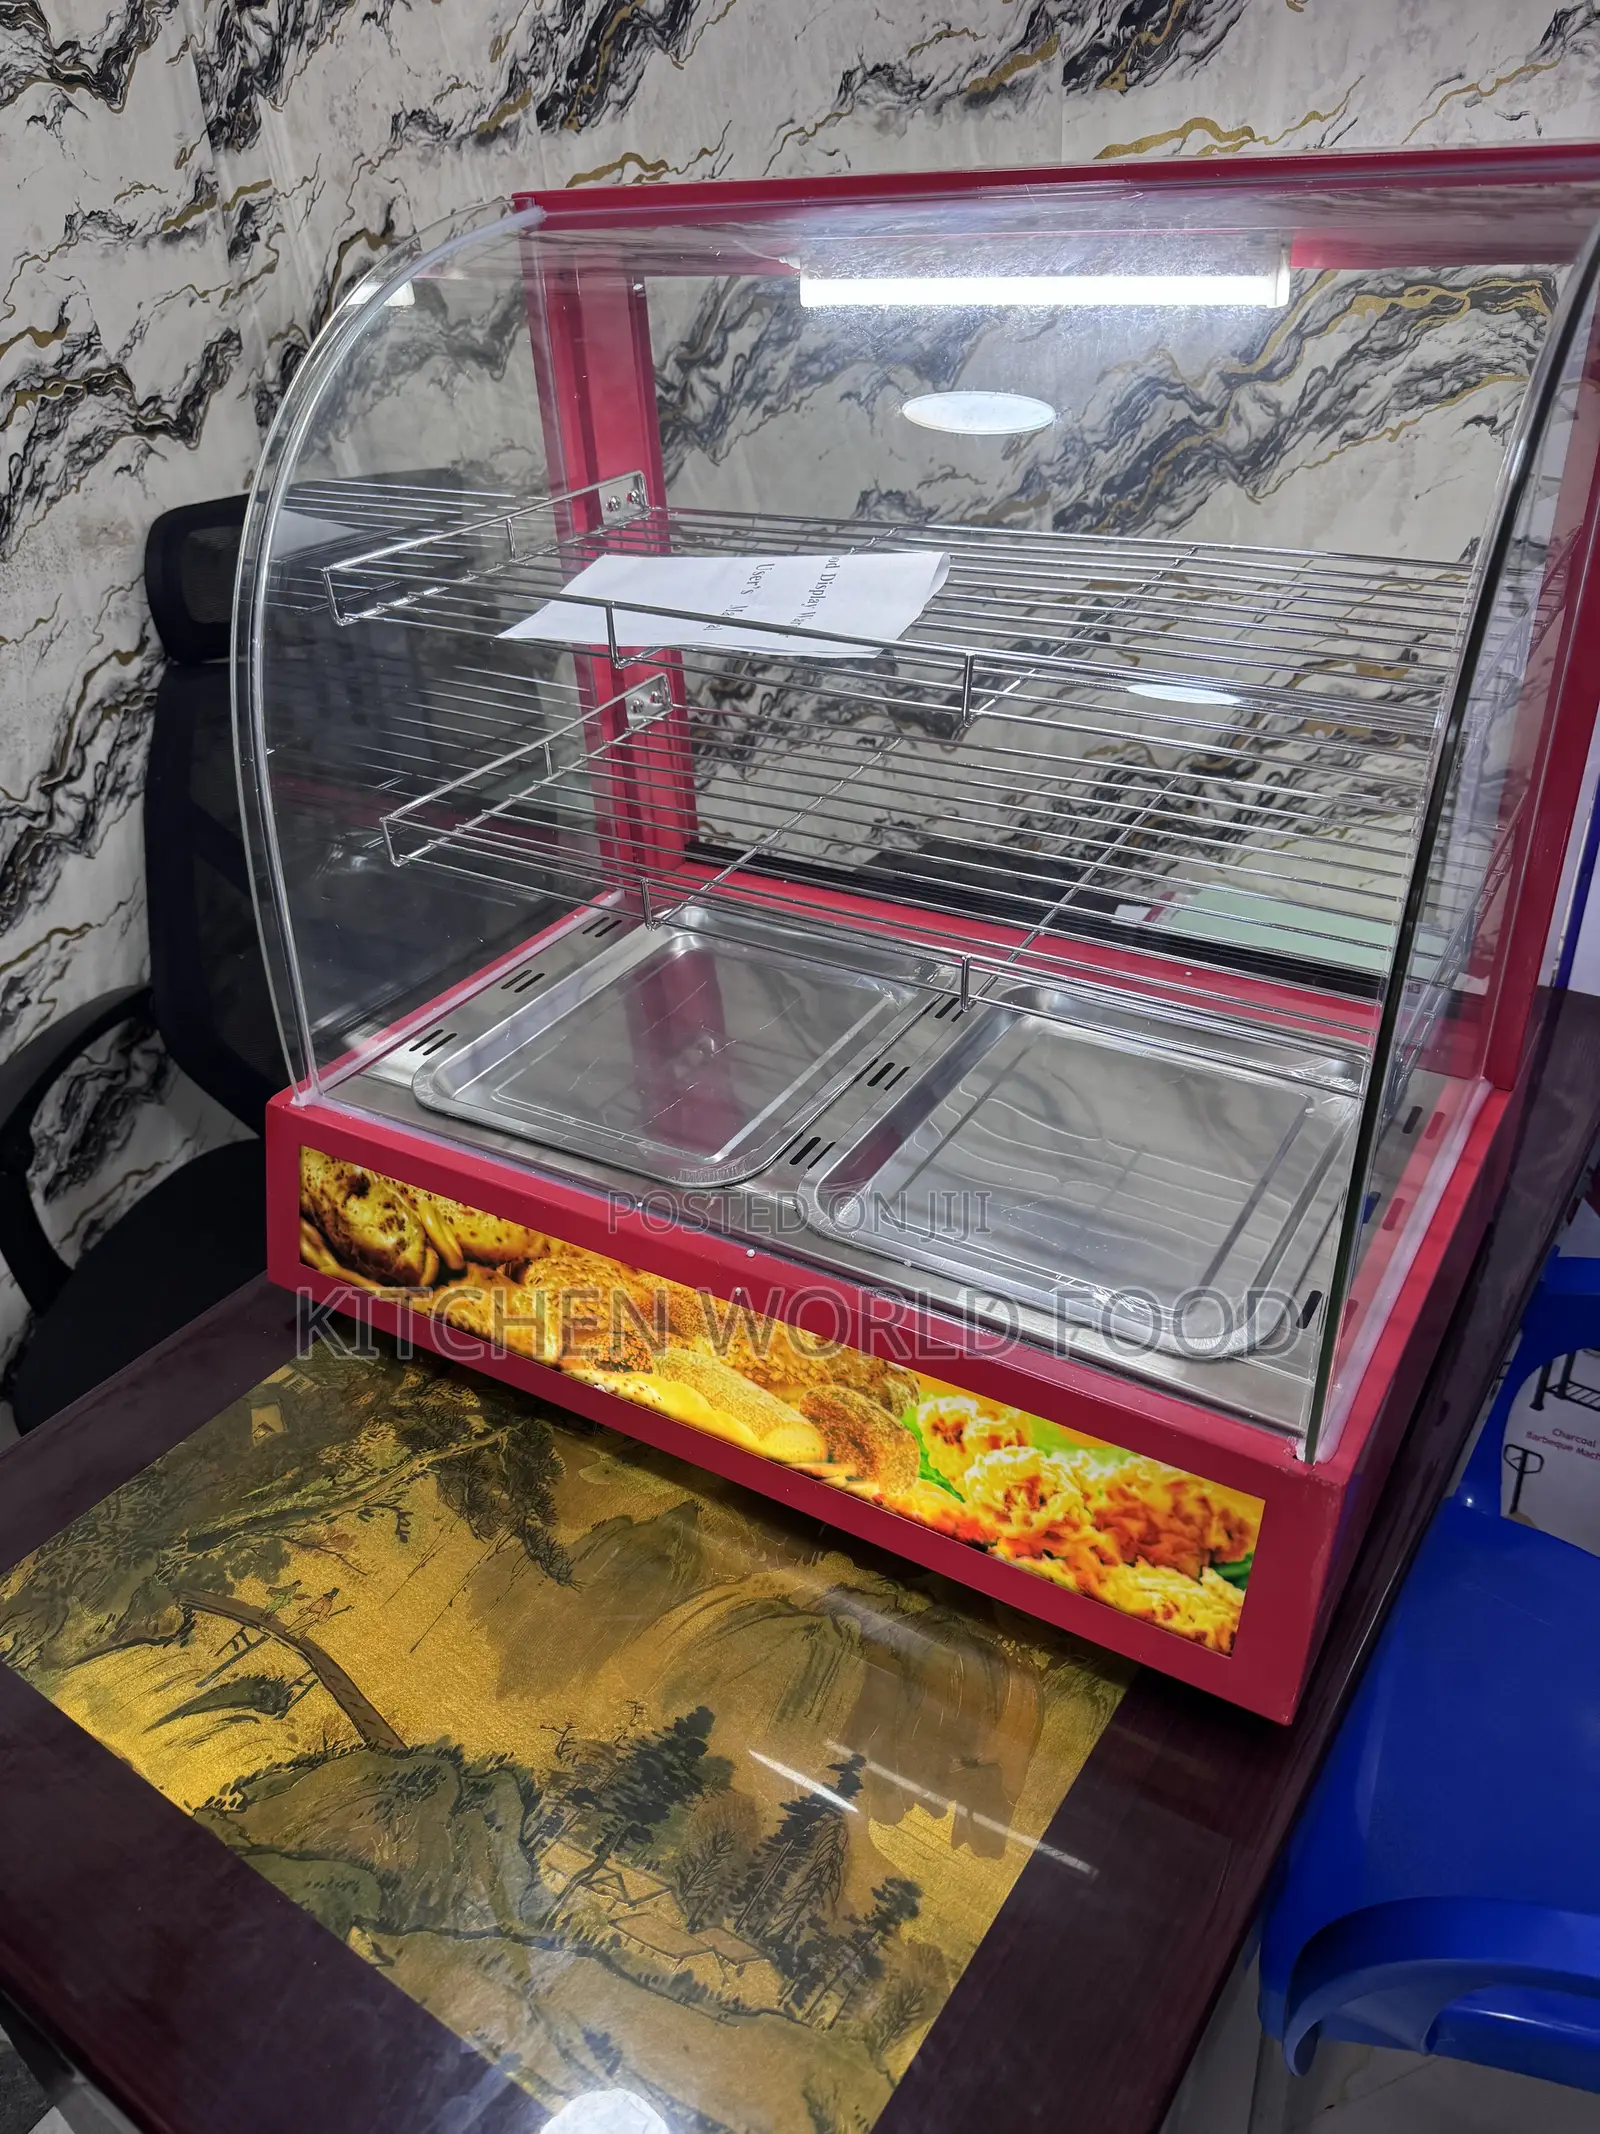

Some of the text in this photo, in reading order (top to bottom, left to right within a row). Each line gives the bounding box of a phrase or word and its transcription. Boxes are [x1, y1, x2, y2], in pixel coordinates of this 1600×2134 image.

[740, 563, 776, 595] User's
[801, 573, 837, 609] Display
[1525, 1430, 1574, 1451] Barbeque
[1551, 1427, 1597, 1448] Charcoal
